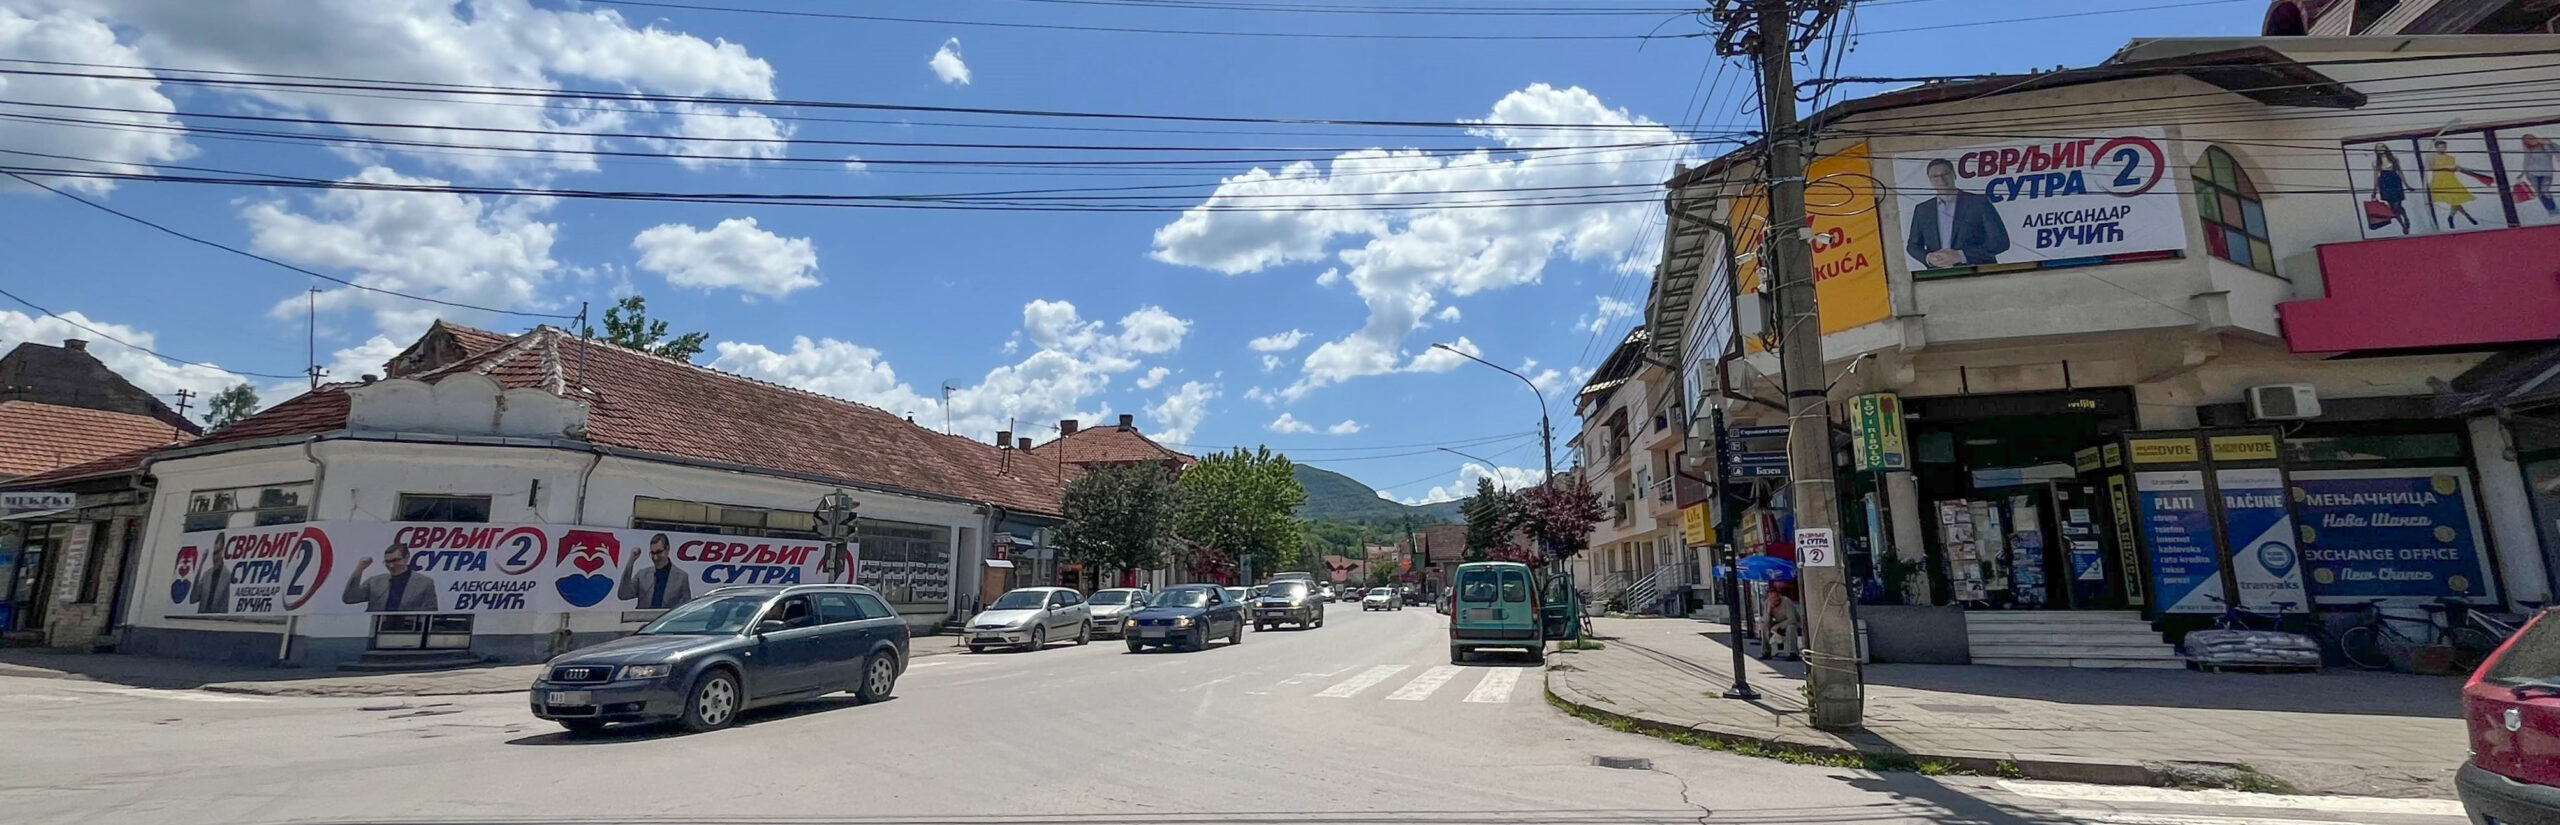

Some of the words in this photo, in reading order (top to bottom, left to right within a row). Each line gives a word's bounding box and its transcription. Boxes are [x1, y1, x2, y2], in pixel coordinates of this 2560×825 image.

[1958, 139, 2095, 179] СВРЉИГ
[2112, 148, 2141, 187] 2
[1985, 170, 2087, 203] СУТРА
[2022, 205, 2131, 228] АЛЕКСАНДАР
[2036, 221, 2124, 249] ВУЧИЋ
[1815, 251, 1869, 281] KUĆA
[1863, 400, 1875, 416] LOV
[1867, 427, 1881, 466] RIBOLOV
[2158, 446, 2192, 455] OVDE
[2239, 442, 2272, 452] OVDE
[2154, 497, 2194, 510] PLATI
[2226, 493, 2283, 508] RAČUNE
[2306, 492, 2438, 507] МЕЊАЧНИЦА
[2322, 513, 2368, 528] Нова
[224, 531, 298, 560] СВРЉИГ
[393, 527, 505, 549] СВРЉИГ
[506, 536, 532, 566] 2
[677, 540, 818, 565] СВРЉИГ
[1812, 551, 1820, 561] 2
[2305, 549, 2394, 561] EXCHANGE
[2399, 549, 2459, 560] OFFICE
[286, 540, 313, 595] 2
[409, 550, 487, 572] СУТРА
[230, 560, 283, 585] СУТРА
[701, 564, 801, 584] СУТРА
[2341, 569, 2375, 580] New
[2378, 568, 2434, 580] Chance
[234, 586, 280, 597] АЛЕКСАНДАР
[448, 580, 536, 592] АЛЕКСАНДАР
[2240, 581, 2299, 590] transaks
[236, 597, 272, 613] ВУЧИЋ
[454, 593, 525, 610] ВУЧИЋ
